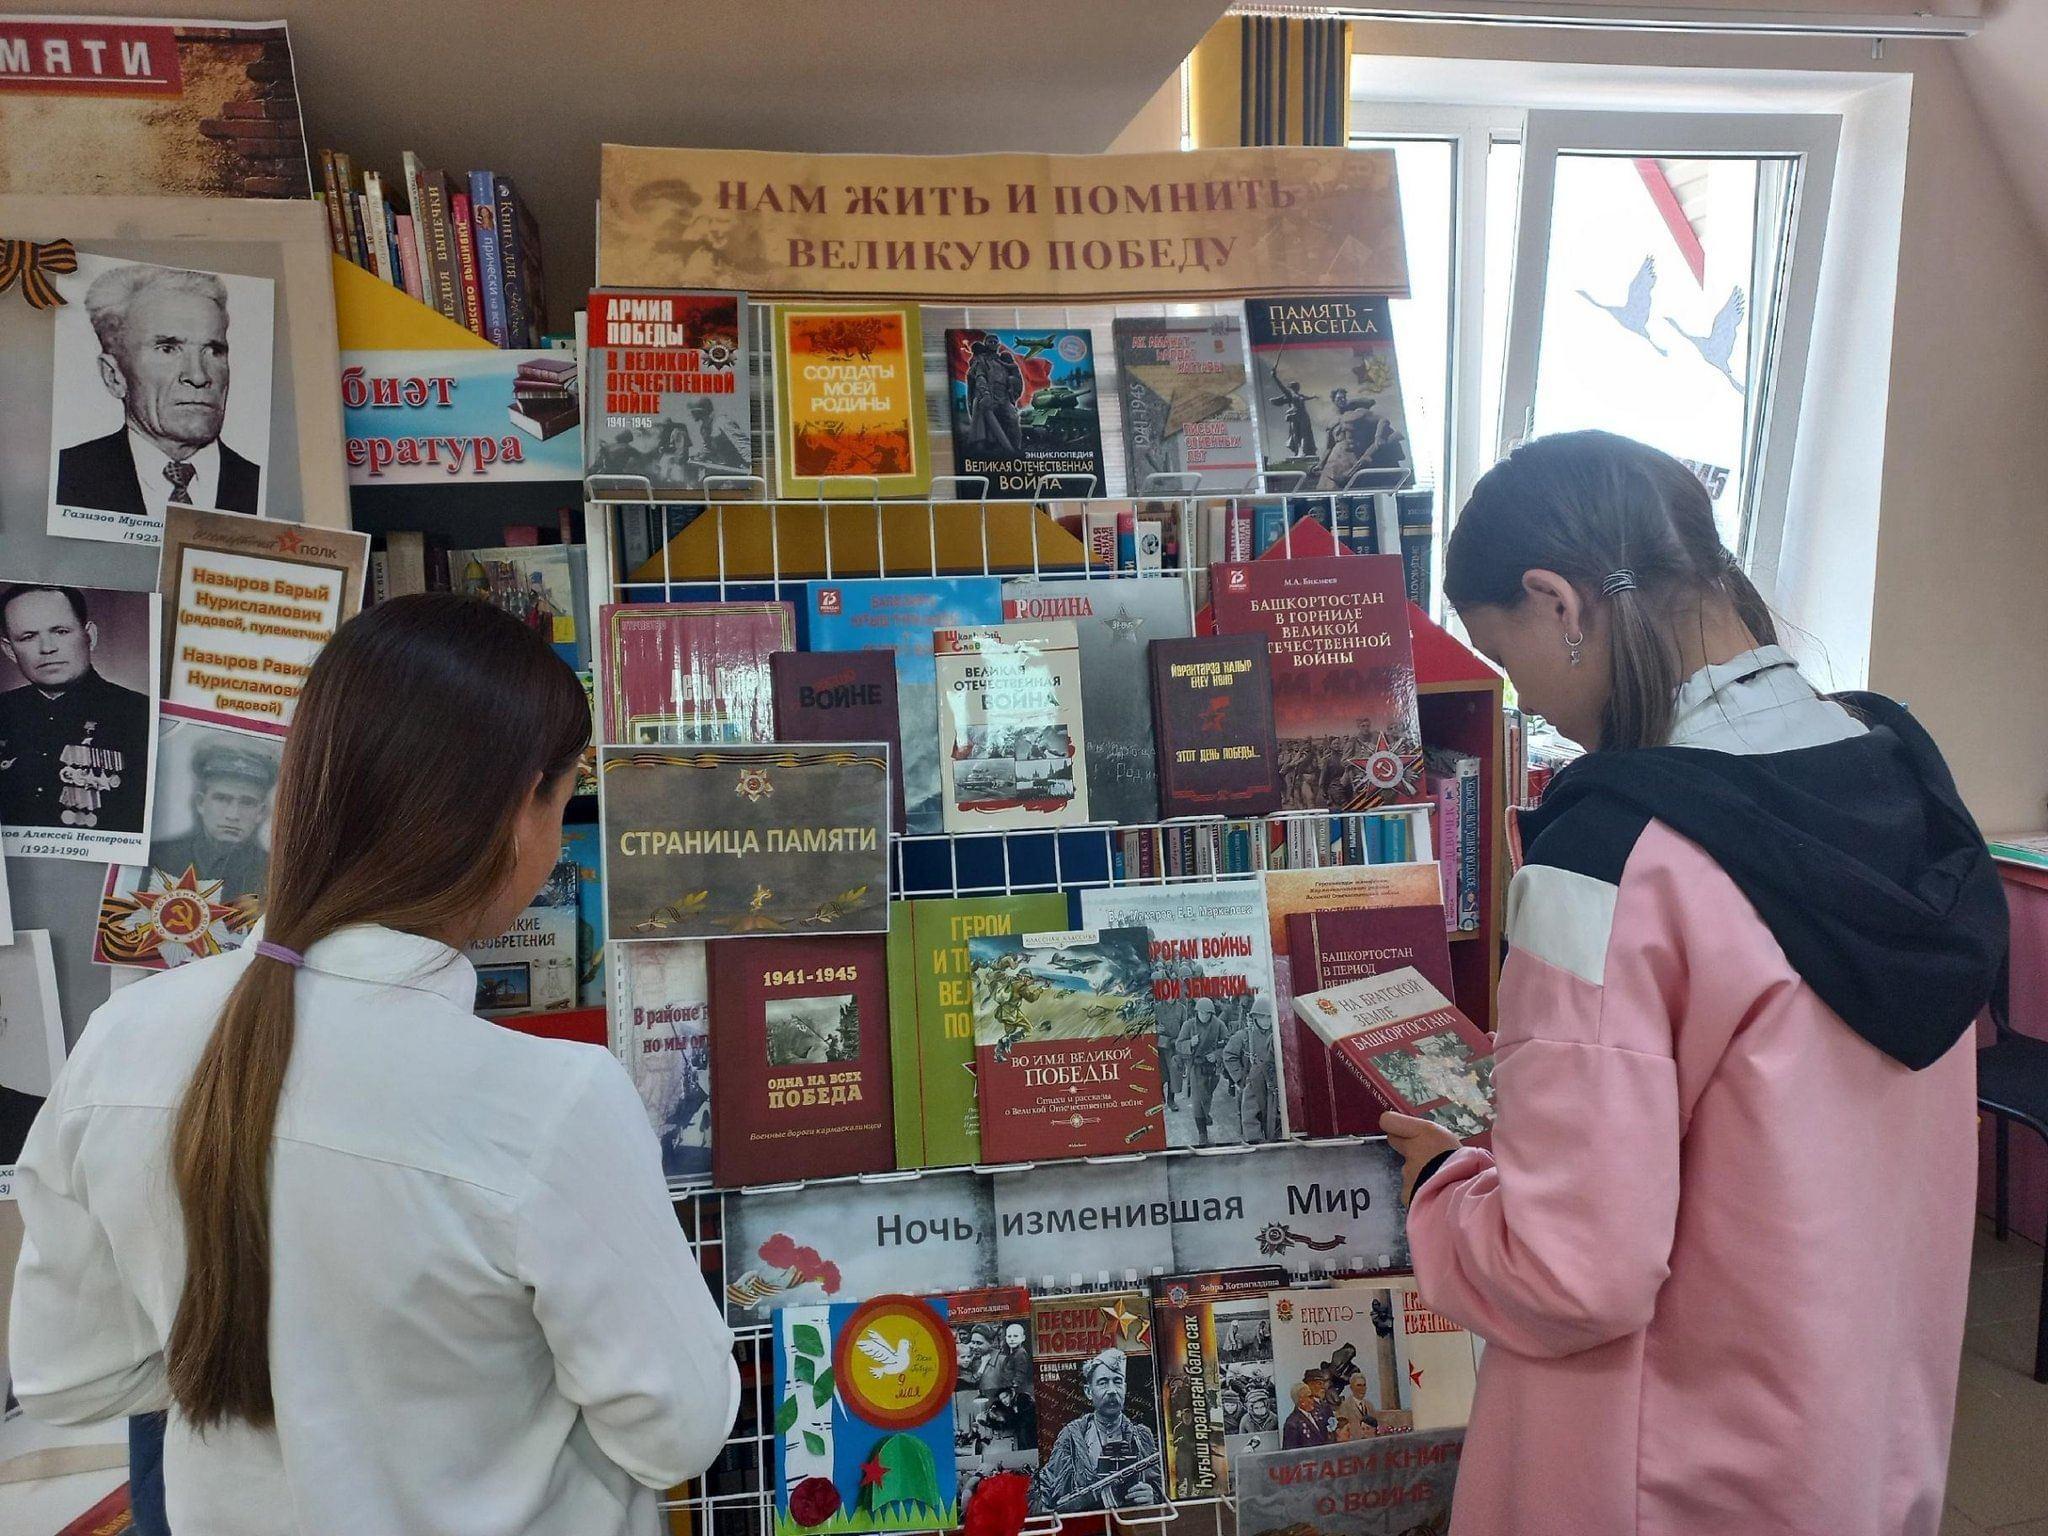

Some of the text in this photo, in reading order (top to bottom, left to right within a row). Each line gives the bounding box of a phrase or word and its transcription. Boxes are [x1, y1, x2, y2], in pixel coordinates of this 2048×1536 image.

[718, 179, 1296, 216] НАМ ЖИТЬ И ПОМНИТЬ
[428, 186, 449, 261] ВЫПЕЧКИ
[457, 220, 474, 281] ВЫШИВКИ
[787, 236, 1238, 273] ВЕЛИКУЮ ПОБЕДУ
[483, 237, 500, 296] прически
[606, 299, 673, 322] АРМИЯ
[1269, 303, 1356, 320] ПАМЯТЬ
[606, 321, 683, 348] ПОБЕДЫ
[1272, 319, 1379, 336] НАВСЕГДА
[607, 350, 699, 371] В ВЕЛИКОЙ
[606, 372, 735, 394] ОТЕЧЕСТВЕННОЙ
[803, 365, 894, 382] СОЛДАТЫ
[824, 380, 877, 396] МОЕЙ
[606, 392, 660, 414] ВОЙНЕ
[810, 397, 890, 412] РОДИНЫ
[606, 416, 652, 428] 1941-1945
[345, 434, 524, 476] ература
[964, 459, 1094, 473] ВЕЛИКАЯ ОТЕЧЕСТВЕННАЯ
[1025, 450, 1094, 460] ЭНЦИКЛОПЕДИЯ
[999, 474, 1062, 491] ВОЙНА
[62, 508, 115, 523] Газизов
[192, 566, 330, 602] Назыров Барый
[195, 590, 323, 623] Нурисламович
[1015, 597, 1093, 621] РОДИНА
[1250, 592, 1385, 612] БАШКОРТОСТАН
[180, 609, 247, 632] (рядовой,
[1276, 607, 1363, 625] В ГОРНИЛЕ
[1282, 619, 1359, 639] ВЕЛИКОЙ
[182, 645, 258, 671] Назыров
[1293, 650, 1354, 667] ВОЙНЫ
[965, 665, 1026, 678] ВЕЛИКАЯ
[954, 676, 1061, 691] ОТЕЧЕСТВЕННАЯ
[216, 694, 283, 716] (рядовой)
[799, 684, 882, 710] ВОЙНЕ
[981, 690, 1060, 710] ВОЙНА
[1175, 749, 1196, 762] ЭТОТ
[1200, 748, 1220, 762] ДЕНЬ
[23, 829, 73, 840] Алексей
[76, 832, 142, 846] Нестерович
[620, 827, 877, 858] СТРАНИЦА ПАМЯТИ
[20, 844, 90, 857] (1921-1990)
[1199, 904, 1252, 918] Маркелова
[950, 914, 1012, 941] ГЕРОИ
[1202, 931, 1252, 959] ВОЙНЫ
[1321, 947, 1414, 963] БАШКОРТОСТАН
[932, 950, 947, 975] И
[1323, 963, 1377, 977] В ПЕРИОД
[763, 966, 858, 986] 1941-1945
[1338, 997, 1362, 1012] НА
[1359, 978, 1424, 1006] БРАТСКОЙ
[633, 1007, 644, 1026] В
[646, 1003, 699, 1029] районе
[1353, 1005, 1399, 1028] ЗЕМЛЕ
[1350, 1012, 1457, 1051] БАШКОРТОСТАНА
[642, 1036, 687, 1053] но мы
[1011, 1047, 1133, 1067] ВО ИМЯ ВЕЛИКОЙ
[768, 1071, 862, 1090] ОДНА НА ВСЕХ
[1024, 1062, 1121, 1087] ПОБЕДЫ
[768, 1084, 863, 1109] ПОБЕДА
[1012, 1105, 1047, 1116] Великой
[1049, 1101, 1118, 1113] Отечественной
[1120, 1098, 1144, 1108] войне
[1036, 1095, 1066, 1105] Стихи
[1075, 1092, 1112, 1104] рассказы
[876, 1183, 1371, 1246] Ночь, изменившая Мир
[1037, 1308, 1099, 1330] ПЕСНИ
[1037, 1330, 1118, 1355] ПОБЕДЫ
[1302, 1328, 1338, 1346] ЙЫР
[1185, 1342, 1203, 1375] бала
[1040, 1373, 1061, 1383] ВОЙНА
[1269, 1454, 1378, 1486] ЧИТАЕМ
[1315, 1481, 1434, 1517] О ВОЙНЕ
